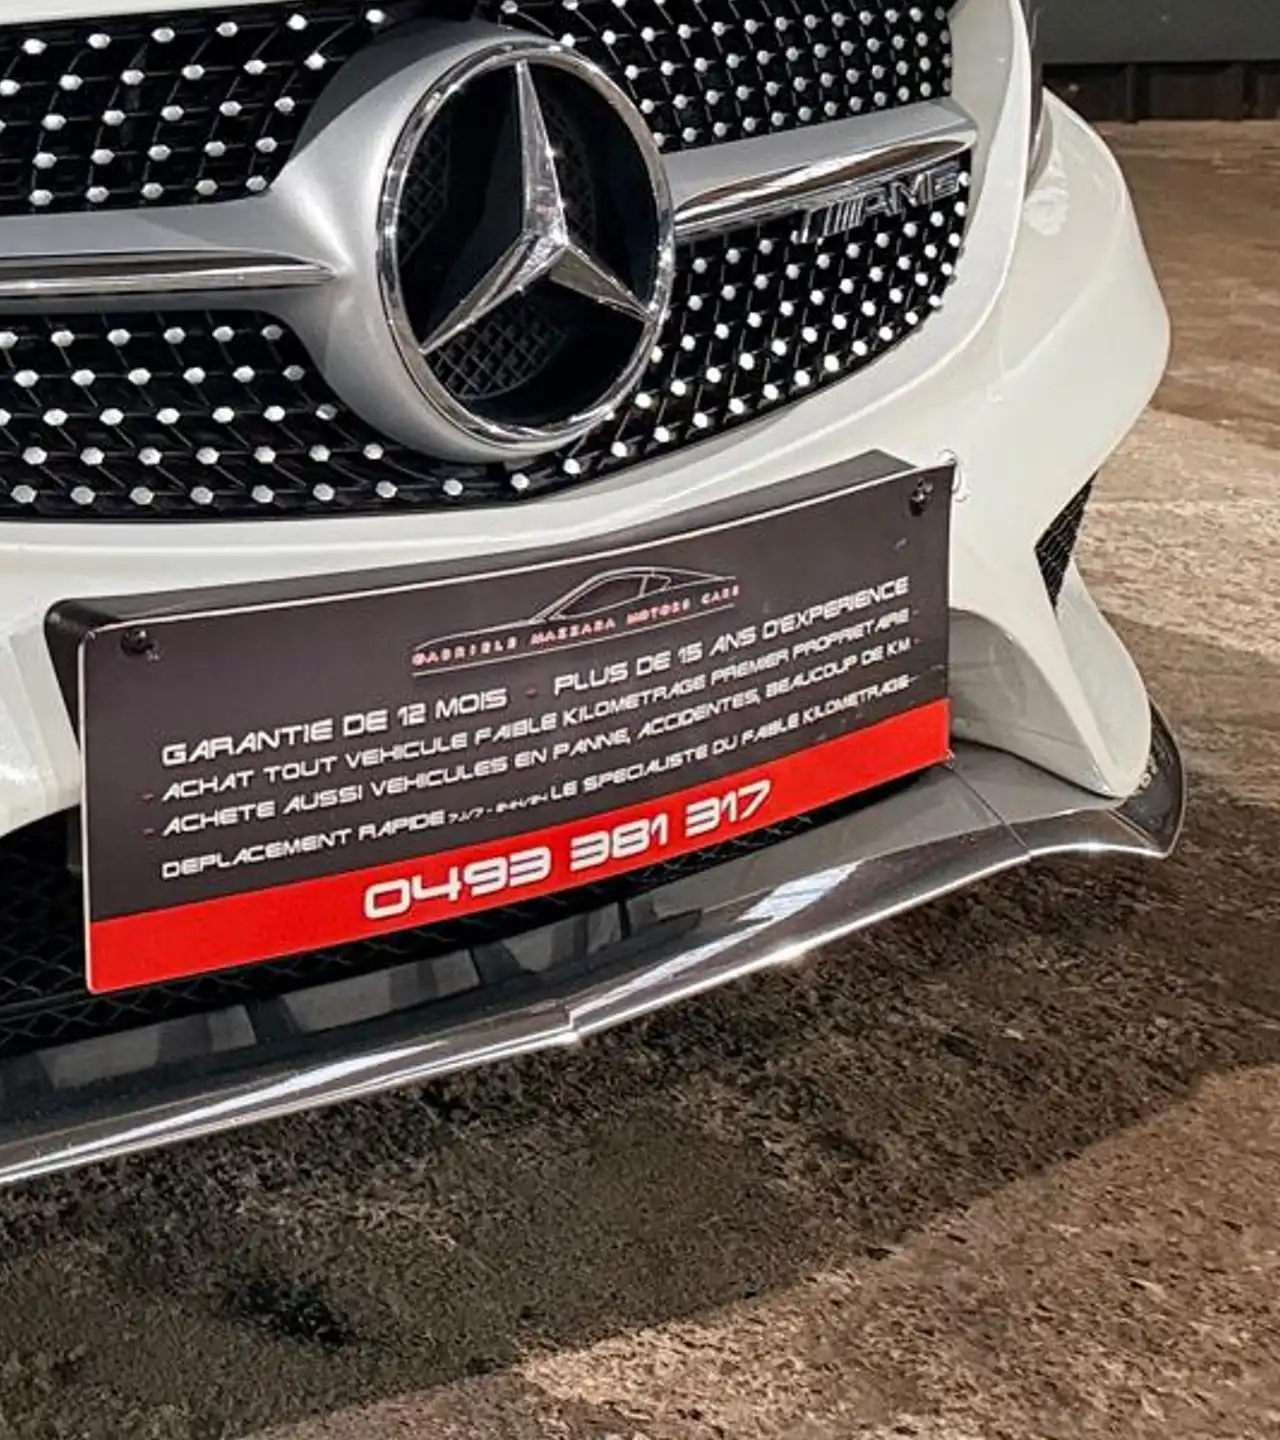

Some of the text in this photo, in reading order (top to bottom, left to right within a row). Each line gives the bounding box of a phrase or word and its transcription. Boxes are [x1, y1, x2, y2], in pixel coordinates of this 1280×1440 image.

[162, 575, 910, 767] GARANTIE DE 12 MOIS PLUS DE 15 ANS D'EXPERIENCE
[162, 770, 256, 802] ACHAT
[263, 755, 338, 784] TOUT
[345, 732, 468, 771] VEHICULE
[474, 713, 556, 745] FAIBLE
[562, 673, 706, 727] KILOMETRAGE
[711, 653, 790, 687] PREMIER
[162, 636, 911, 838] ACHETE AUSSI VEHICULES EN PANNE, ACCIDENTES, BEAUCOUP DE KM
[161, 827, 352, 880] DEPLACEMENT
[358, 809, 446, 841] RAPIDE
[550, 780, 578, 800] LE
[582, 749, 707, 791] SPECIALISTE
[711, 737, 738, 755] DU
[364, 780, 771, 919] 0493 381 317
